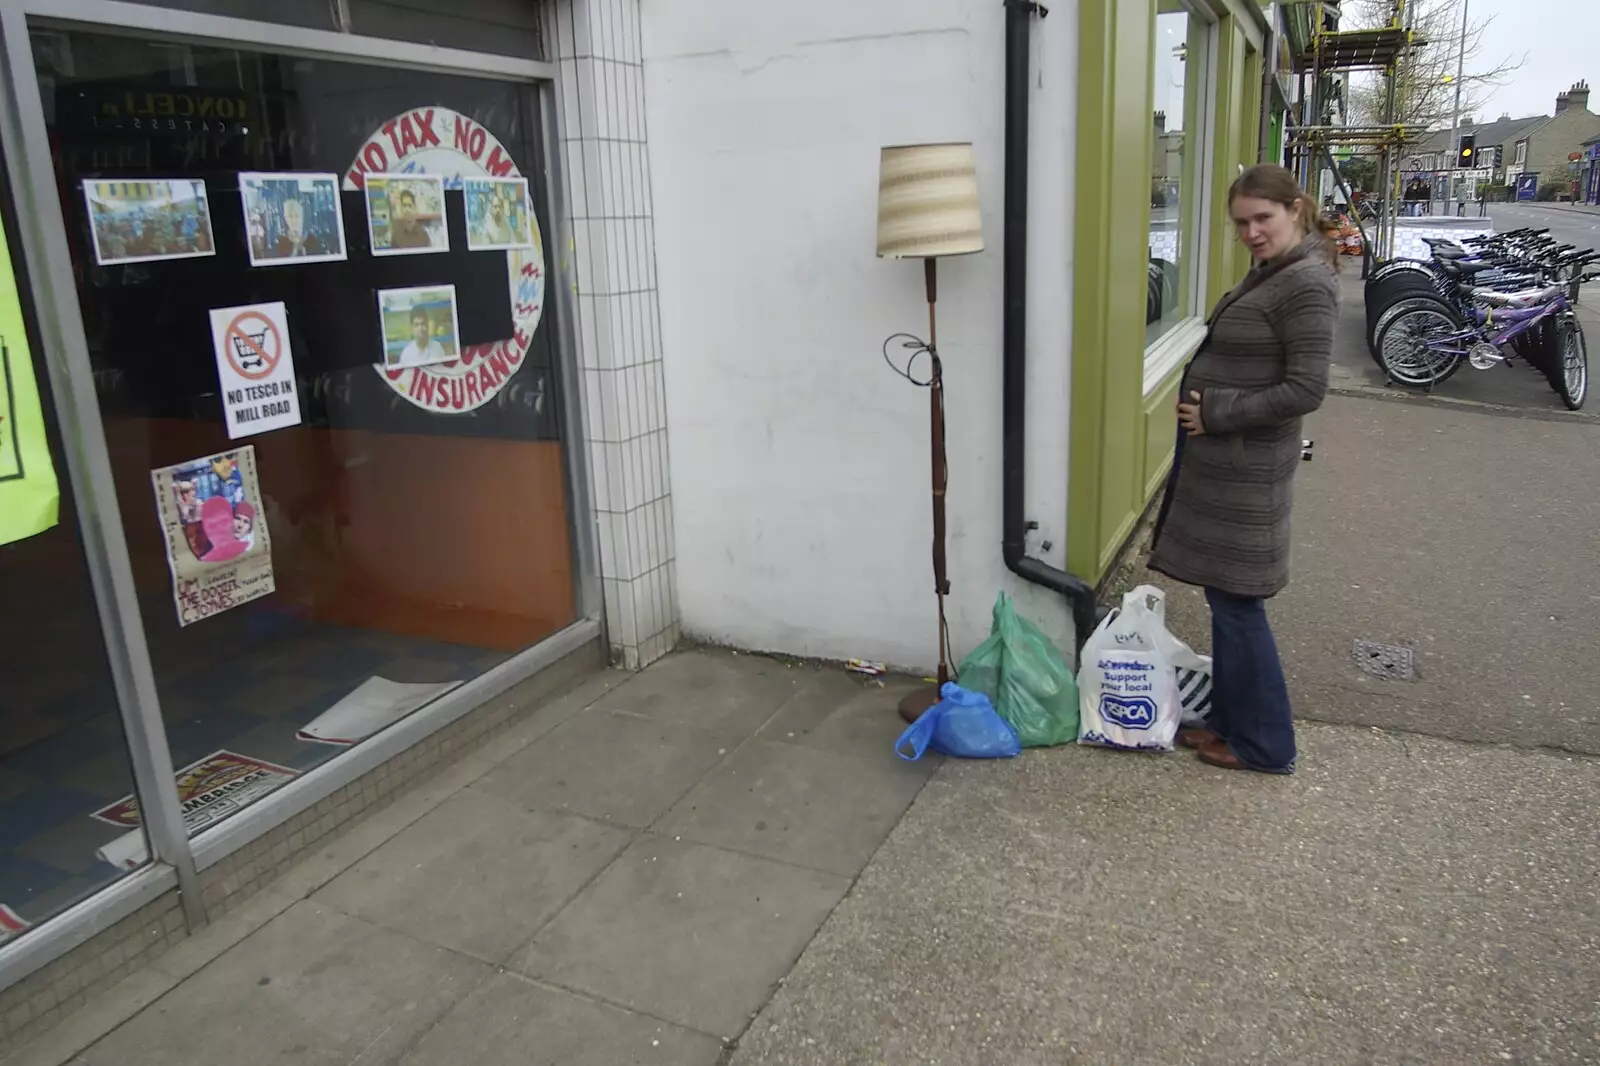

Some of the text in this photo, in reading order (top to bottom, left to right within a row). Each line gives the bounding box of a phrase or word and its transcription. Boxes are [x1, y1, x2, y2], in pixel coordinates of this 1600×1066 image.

[381, 109, 440, 160] TAX
[454, 114, 486, 161] NO
[408, 328, 530, 409] INSURANCE
[226, 380, 292, 405] NO TESCO IN
[235, 400, 291, 423] MILL ROAD
[1104, 672, 1147, 683] Support
[1125, 682, 1152, 691] local
